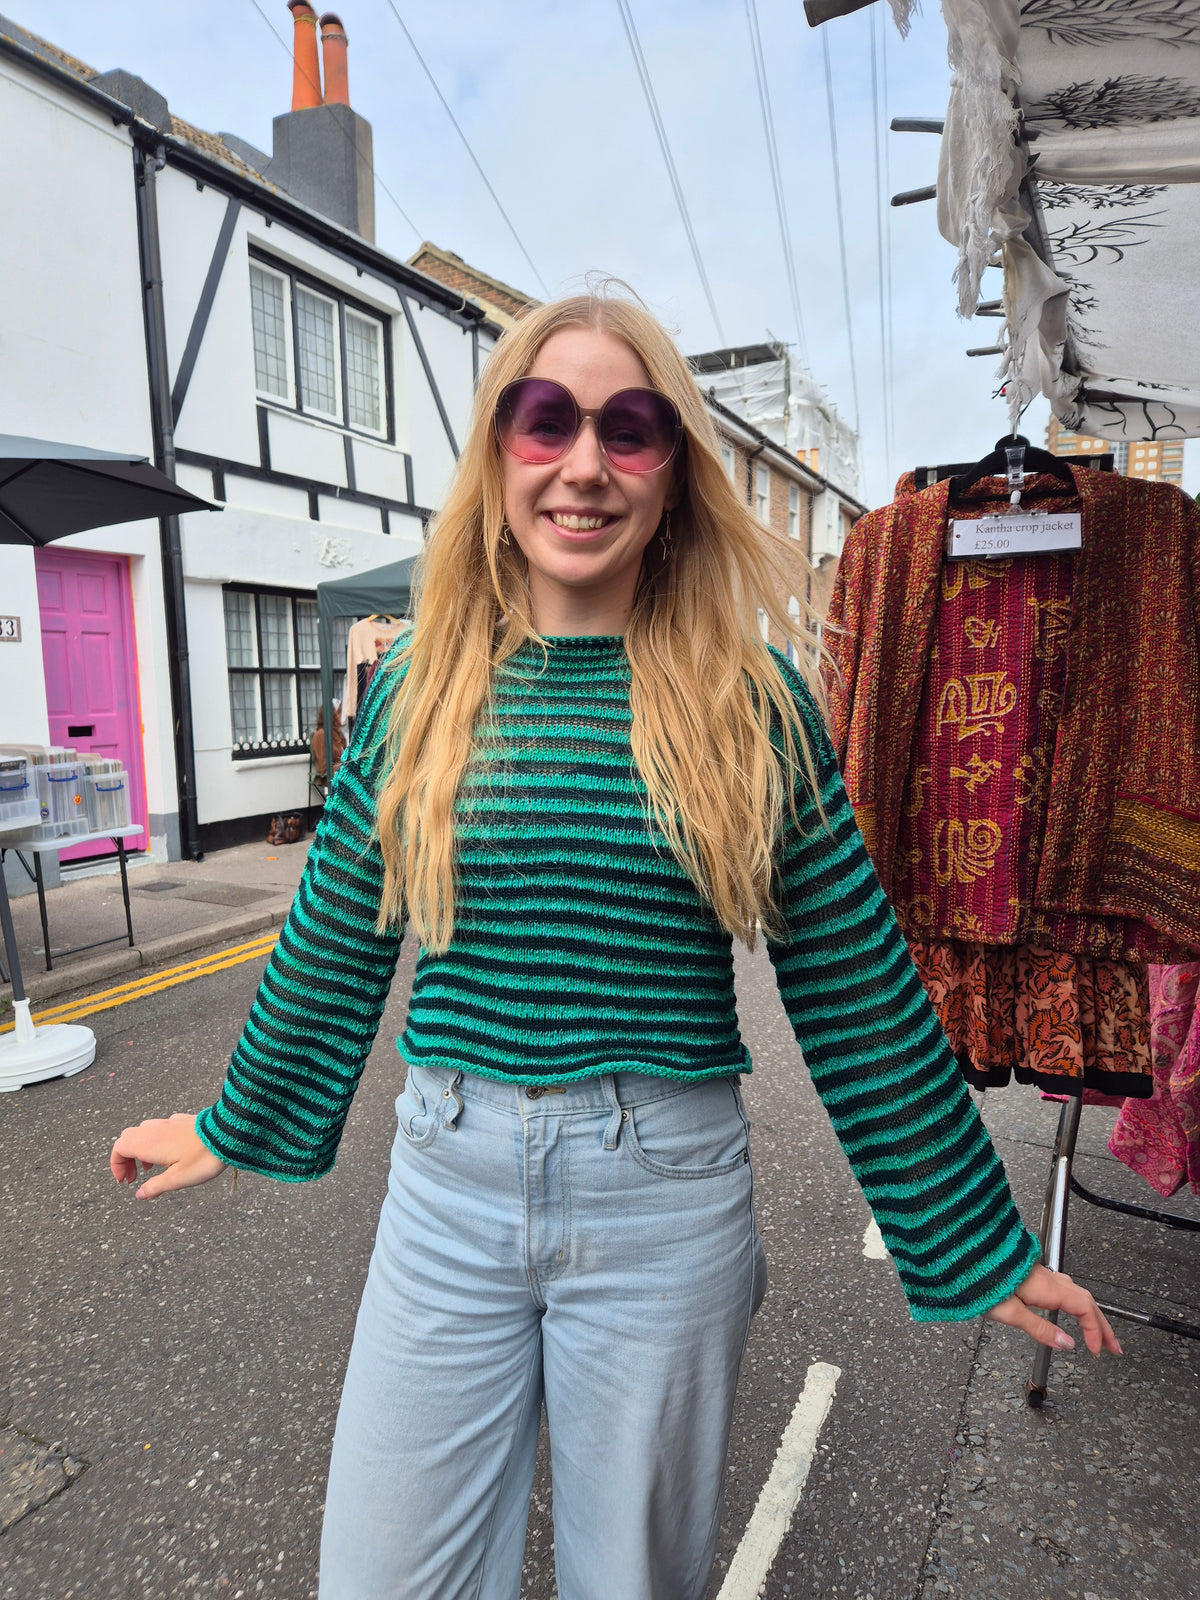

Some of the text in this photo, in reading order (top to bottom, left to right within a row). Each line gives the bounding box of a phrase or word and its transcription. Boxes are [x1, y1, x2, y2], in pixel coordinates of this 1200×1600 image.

[976, 520, 1073, 534] Kantha crop jacket
[974, 539, 1010, 550] £25.00
[0, 619, 14, 637] 3
